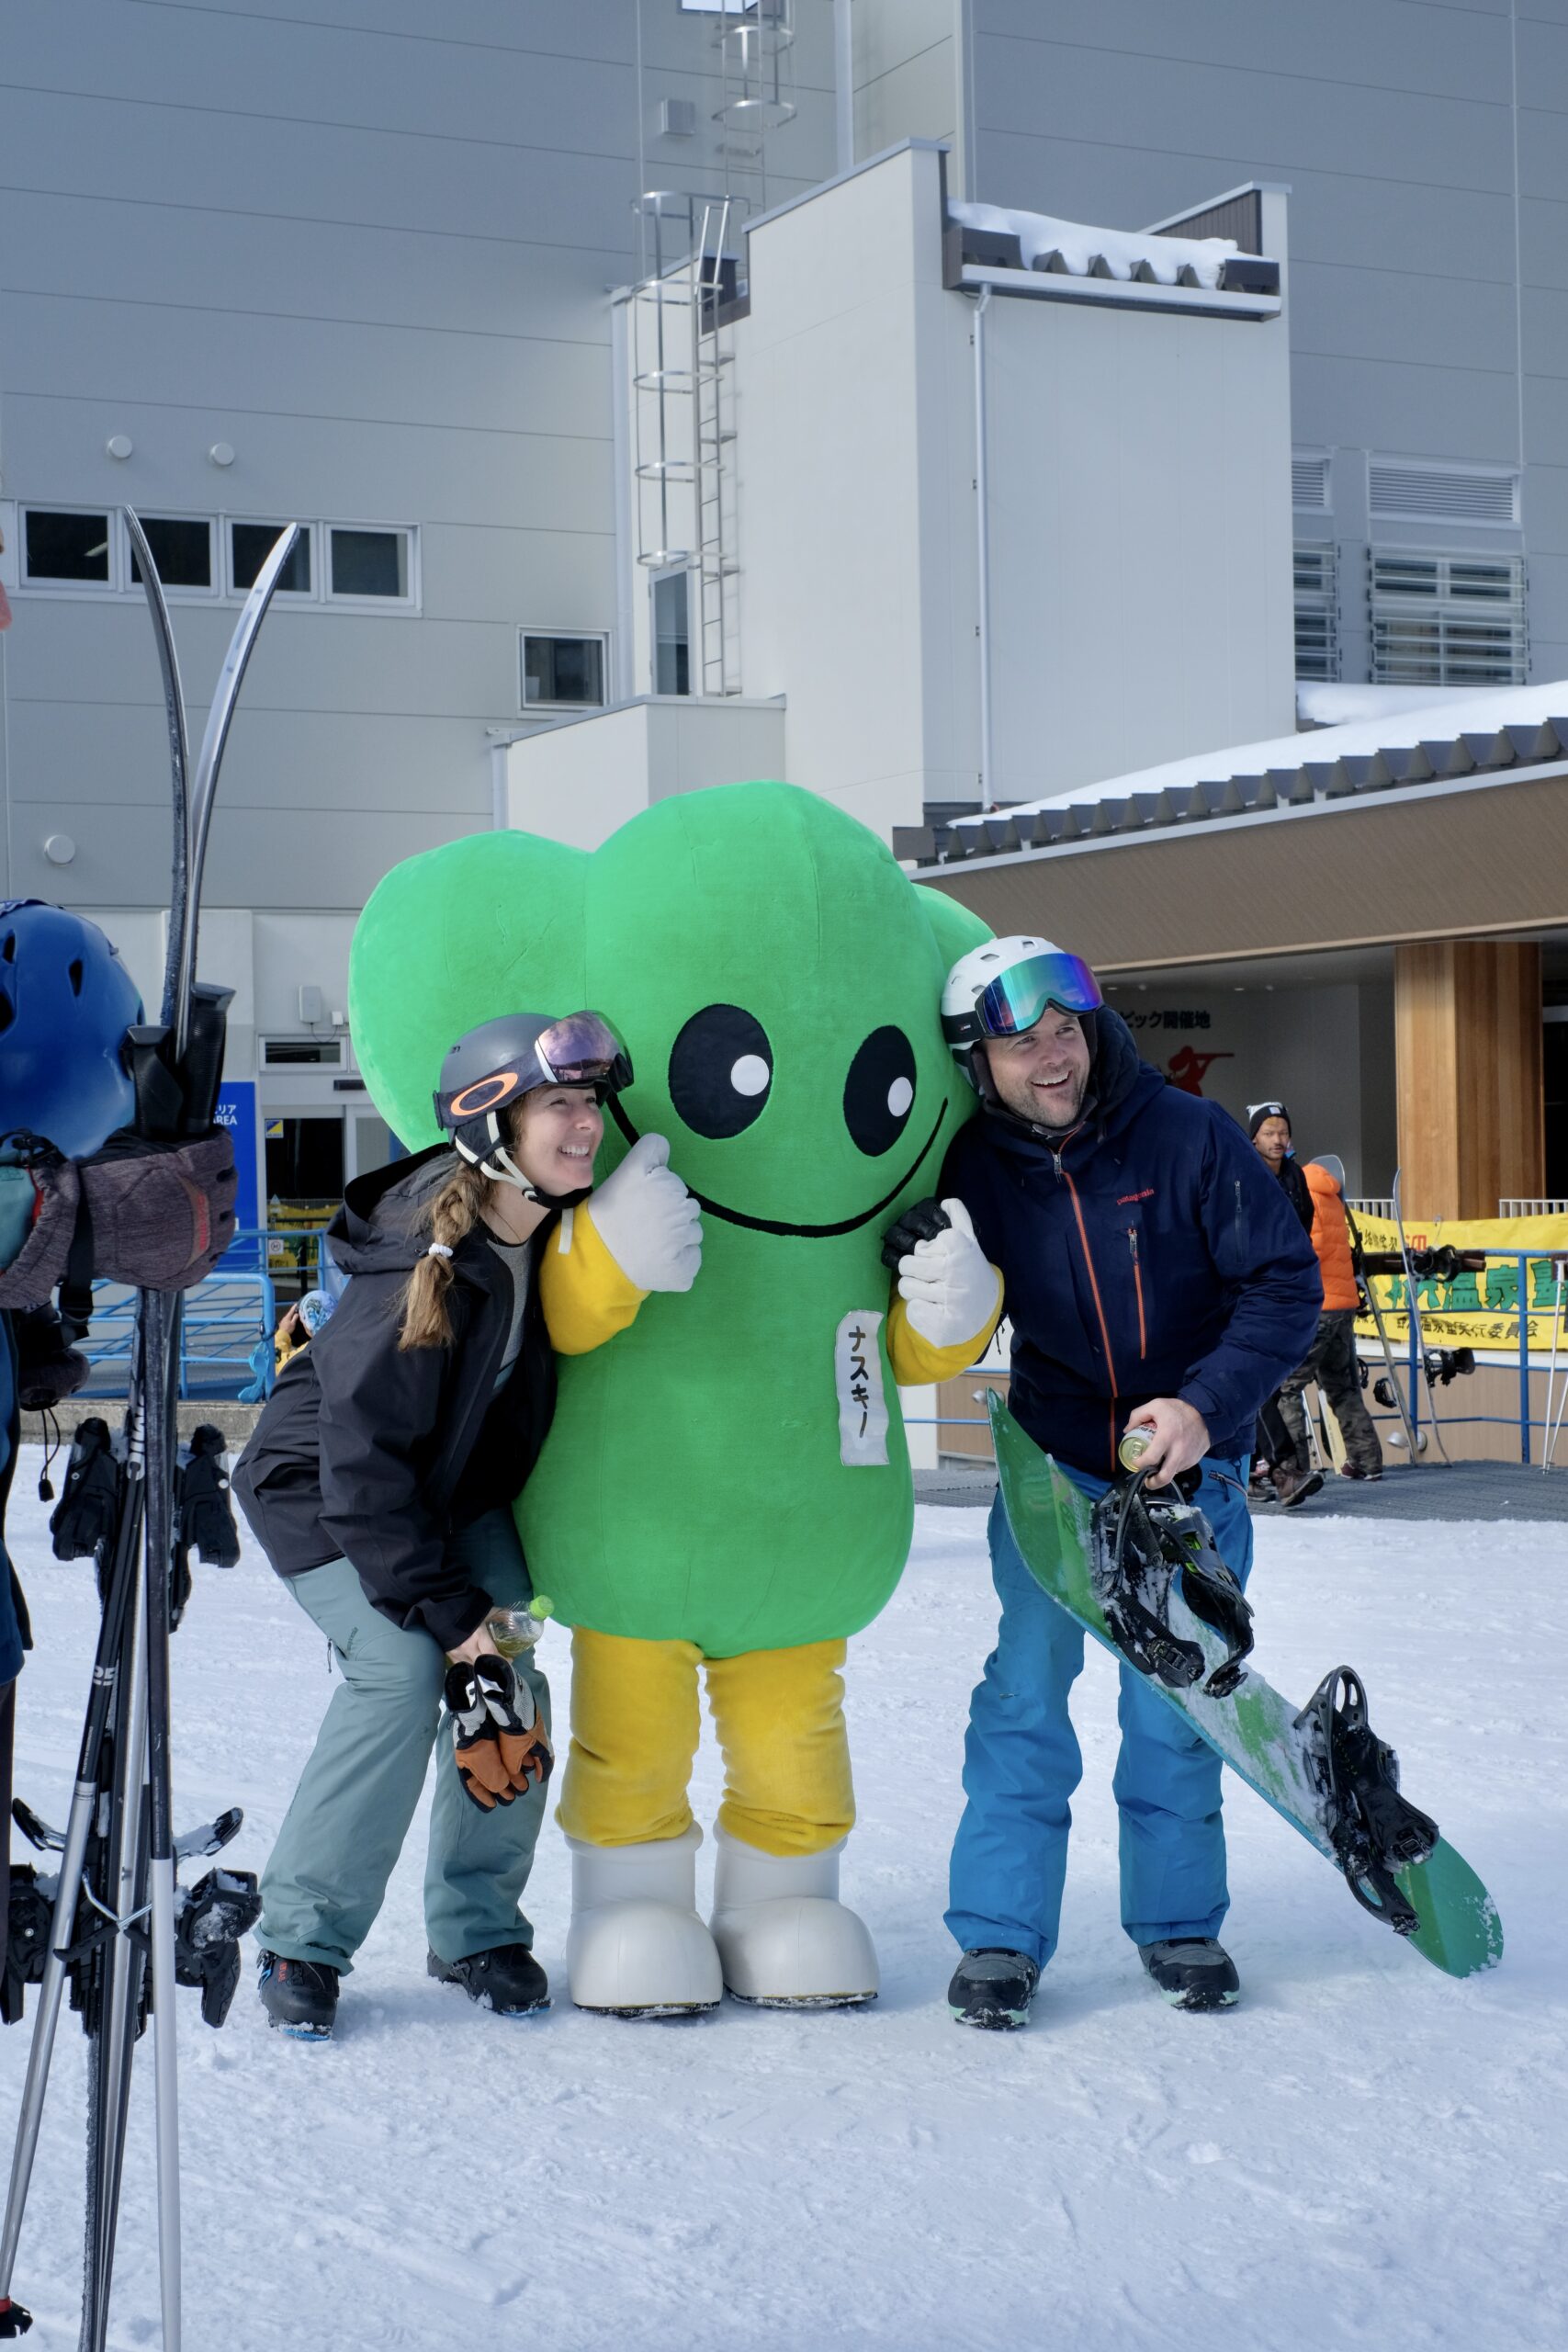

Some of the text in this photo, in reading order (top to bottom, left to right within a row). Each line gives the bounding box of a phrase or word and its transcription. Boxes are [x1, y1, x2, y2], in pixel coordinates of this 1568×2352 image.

[214, 1104, 237, 1114] リア
[1116, 1188, 1155, 1205] patagonia
[848, 1325, 870, 1439] ナスキー
